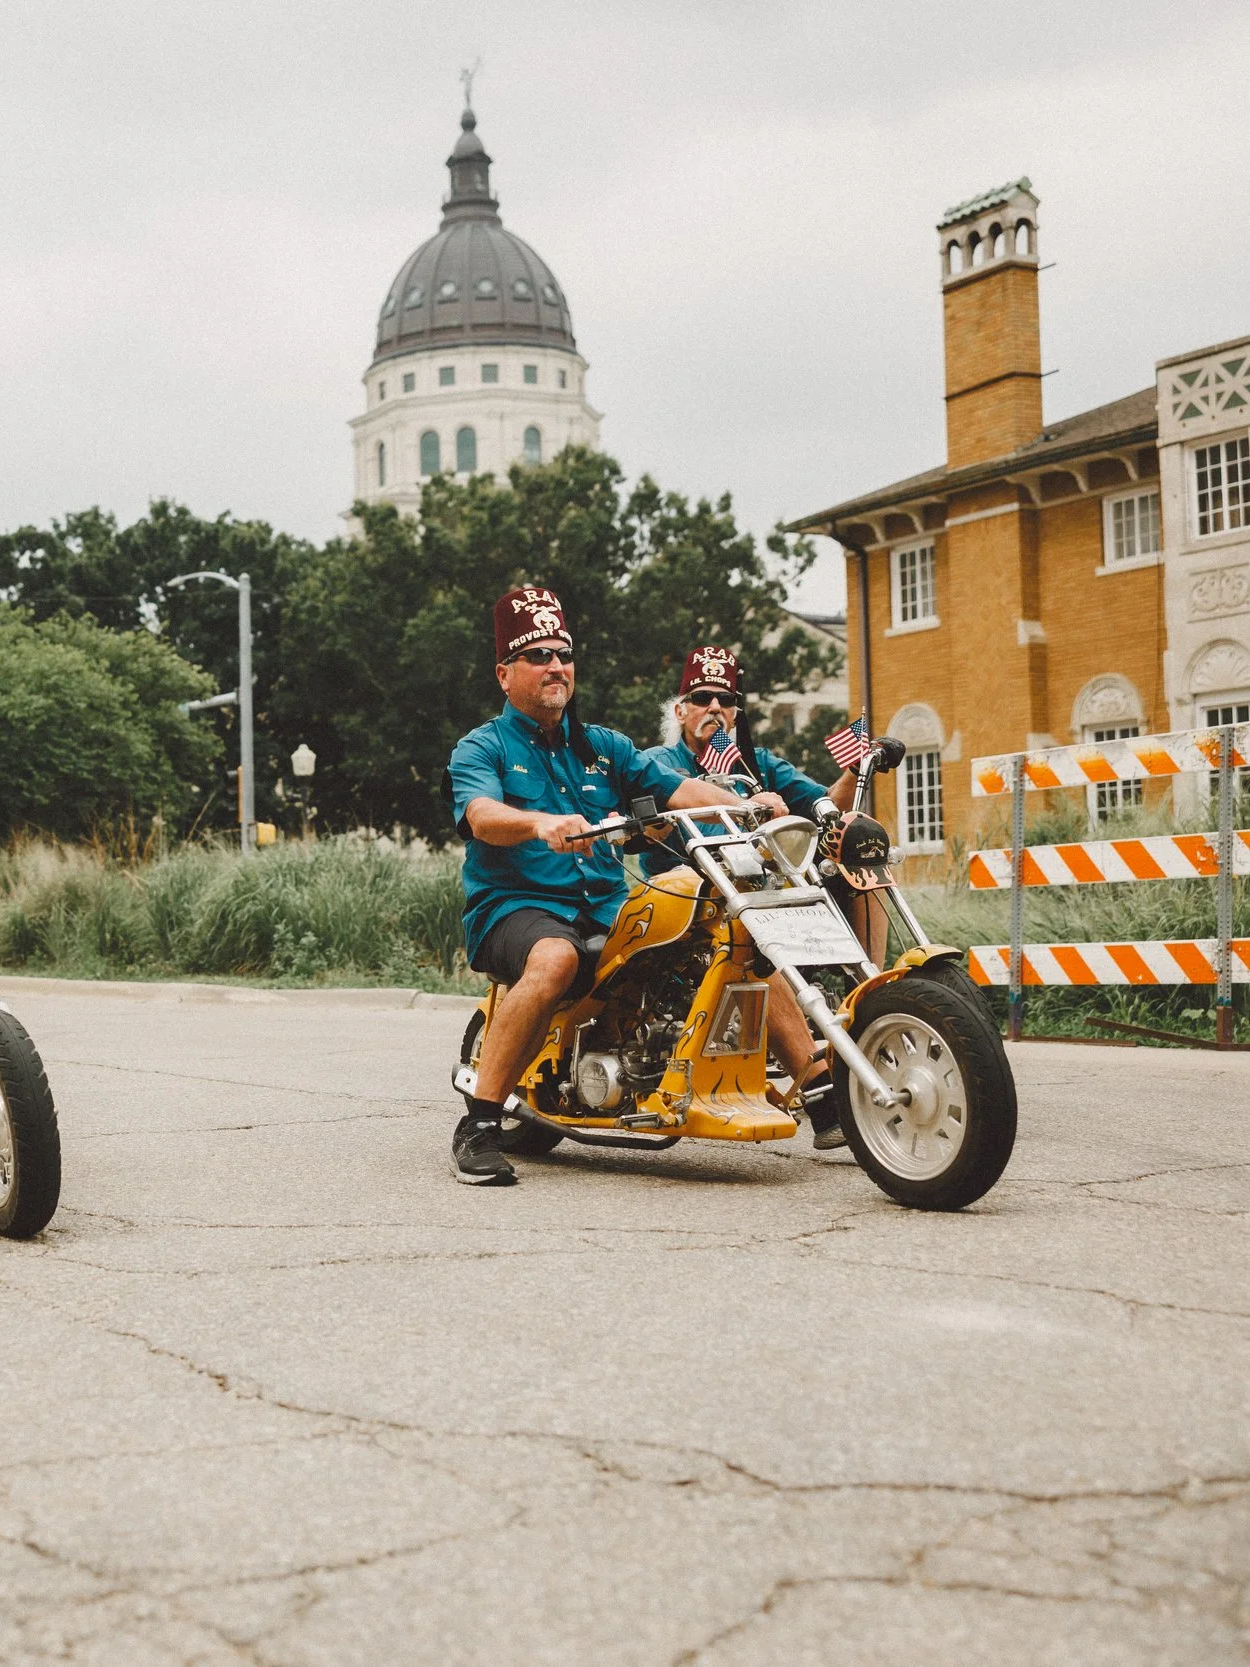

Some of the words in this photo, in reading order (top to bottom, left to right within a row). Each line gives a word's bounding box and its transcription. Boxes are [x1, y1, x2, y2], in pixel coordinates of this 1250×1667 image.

[508, 628, 554, 650] PROVOST
[692, 646, 735, 666] ARAB
[705, 676, 731, 688] CHOPS
